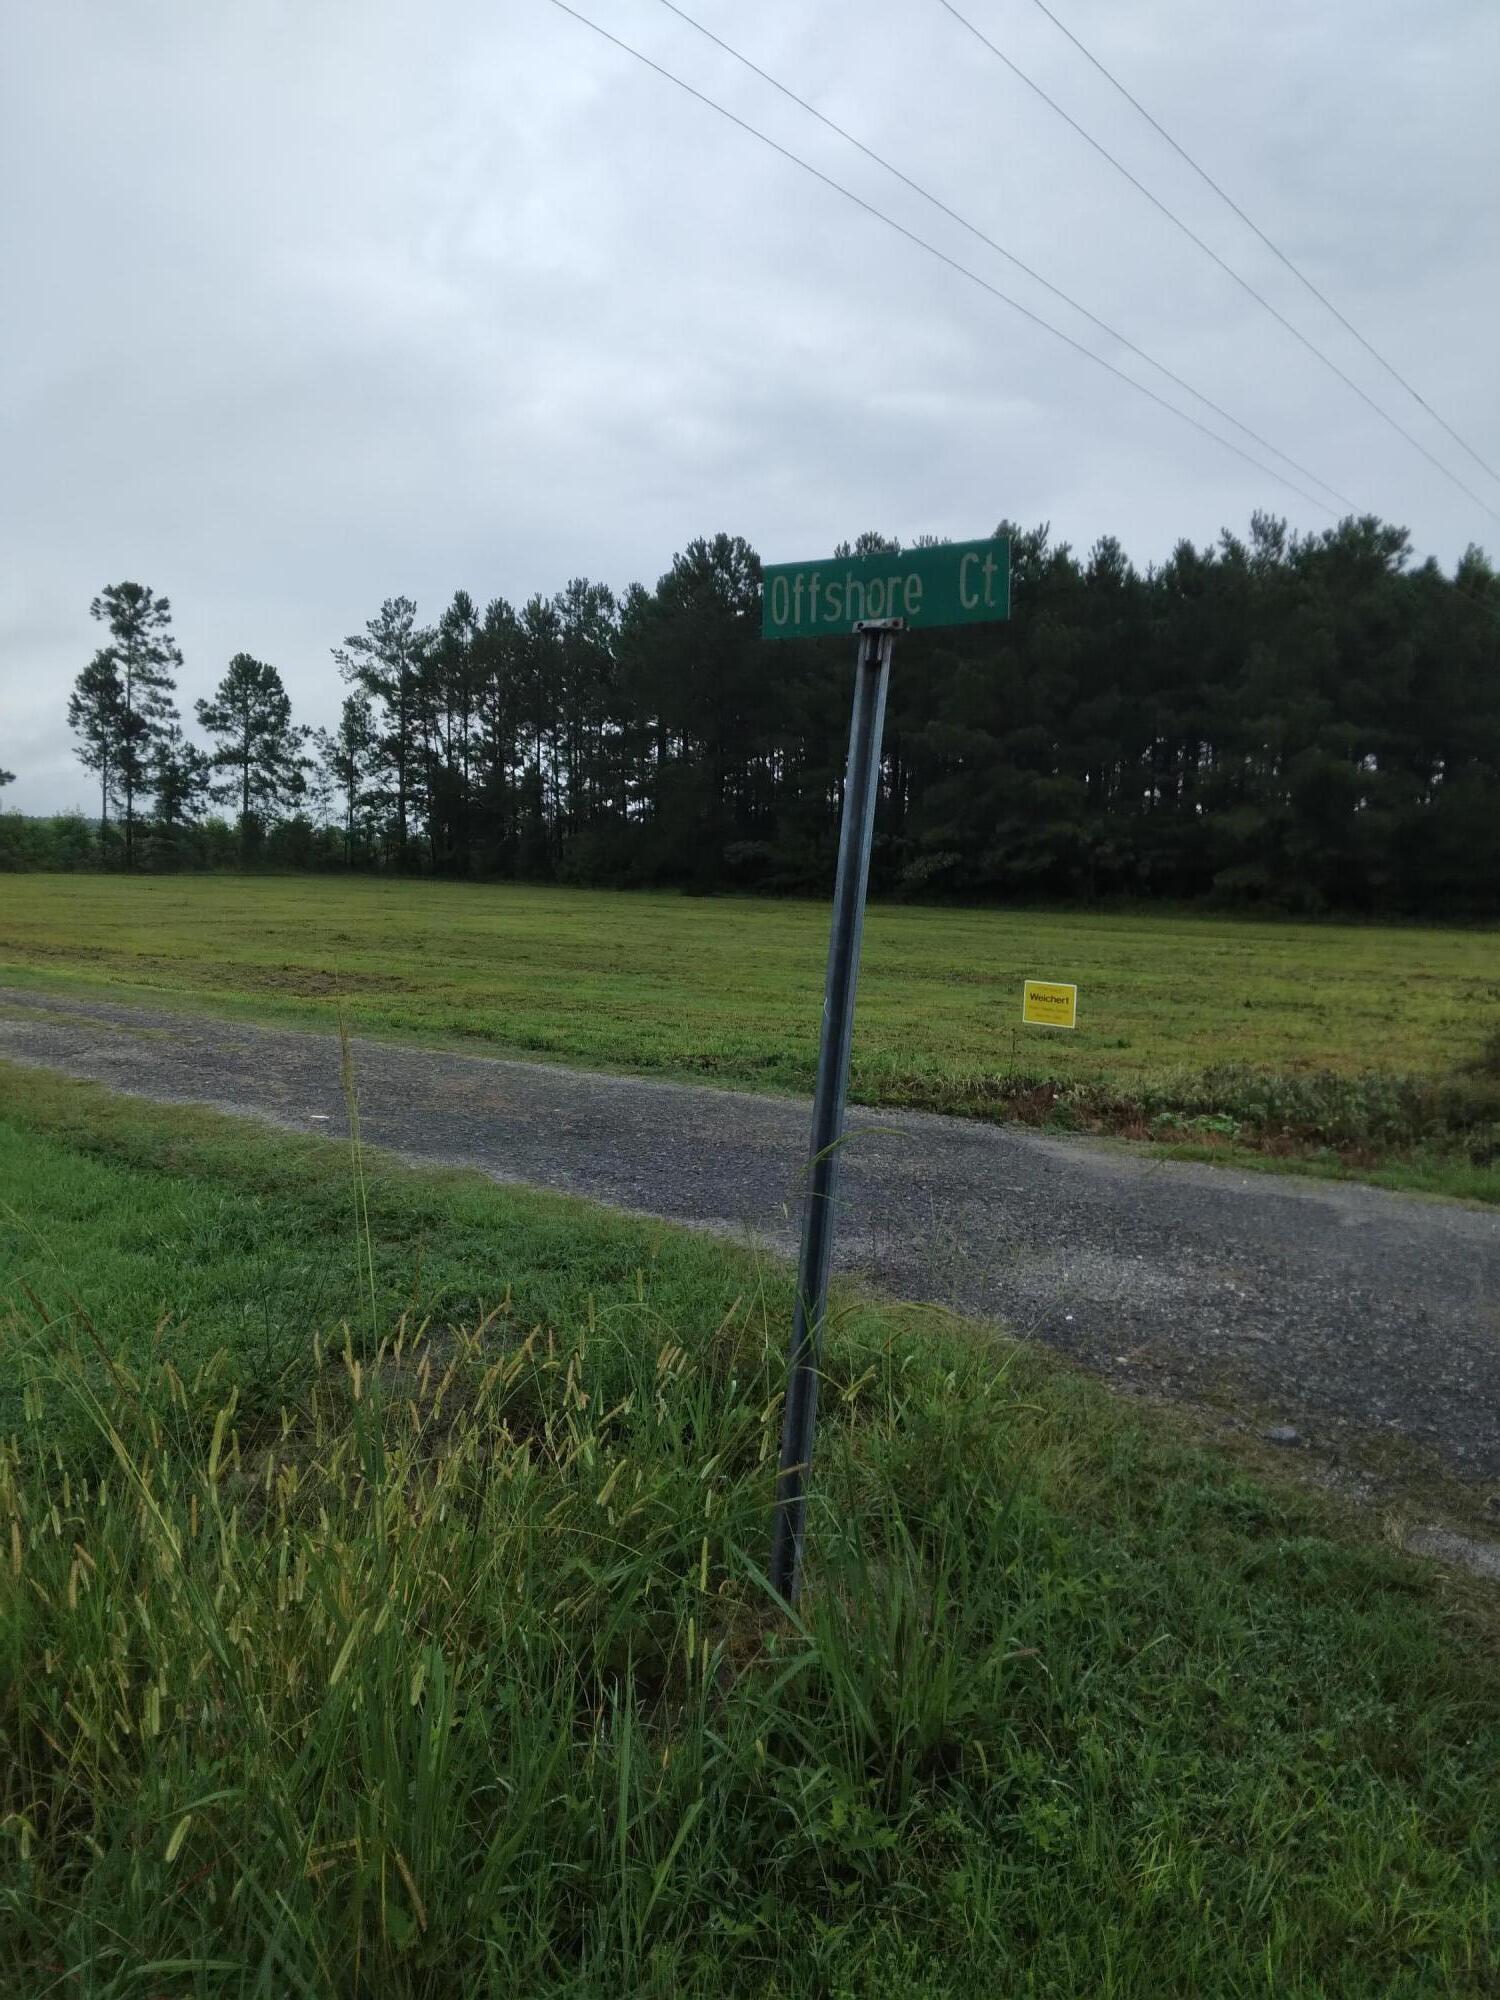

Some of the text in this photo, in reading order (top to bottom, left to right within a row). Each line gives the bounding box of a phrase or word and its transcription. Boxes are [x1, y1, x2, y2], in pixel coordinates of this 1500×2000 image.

[771, 552, 998, 625] Offshore Ct
[1030, 992, 1069, 1005] Weichert
